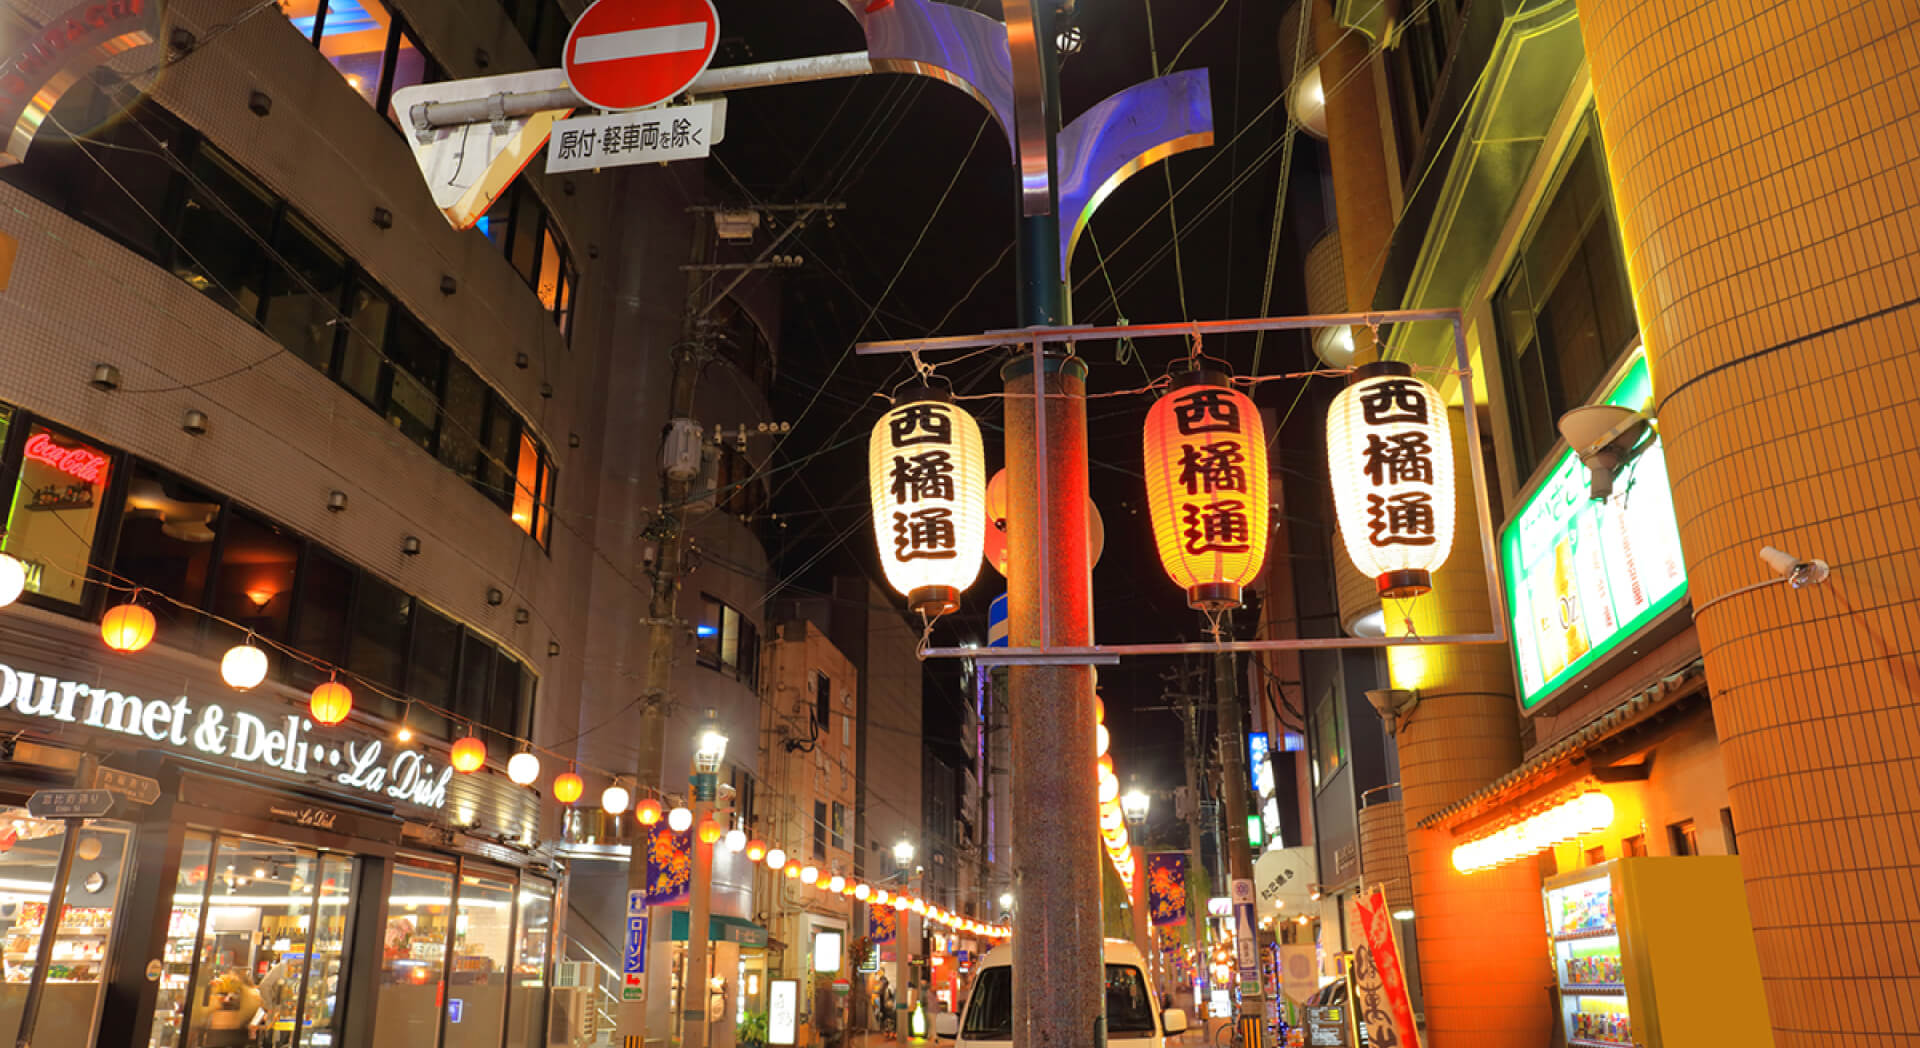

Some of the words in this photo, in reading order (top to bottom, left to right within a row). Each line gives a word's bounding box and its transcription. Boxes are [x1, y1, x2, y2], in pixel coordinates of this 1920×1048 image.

[890, 402, 956, 563] 西橘通
[1175, 387, 1250, 556] 西橘通
[1359, 378, 1436, 547] 西橘通
[194, 704, 229, 754] &
[337, 740, 383, 792] La
[387, 750, 454, 809] Dish
[628, 919, 642, 971] ローソン
